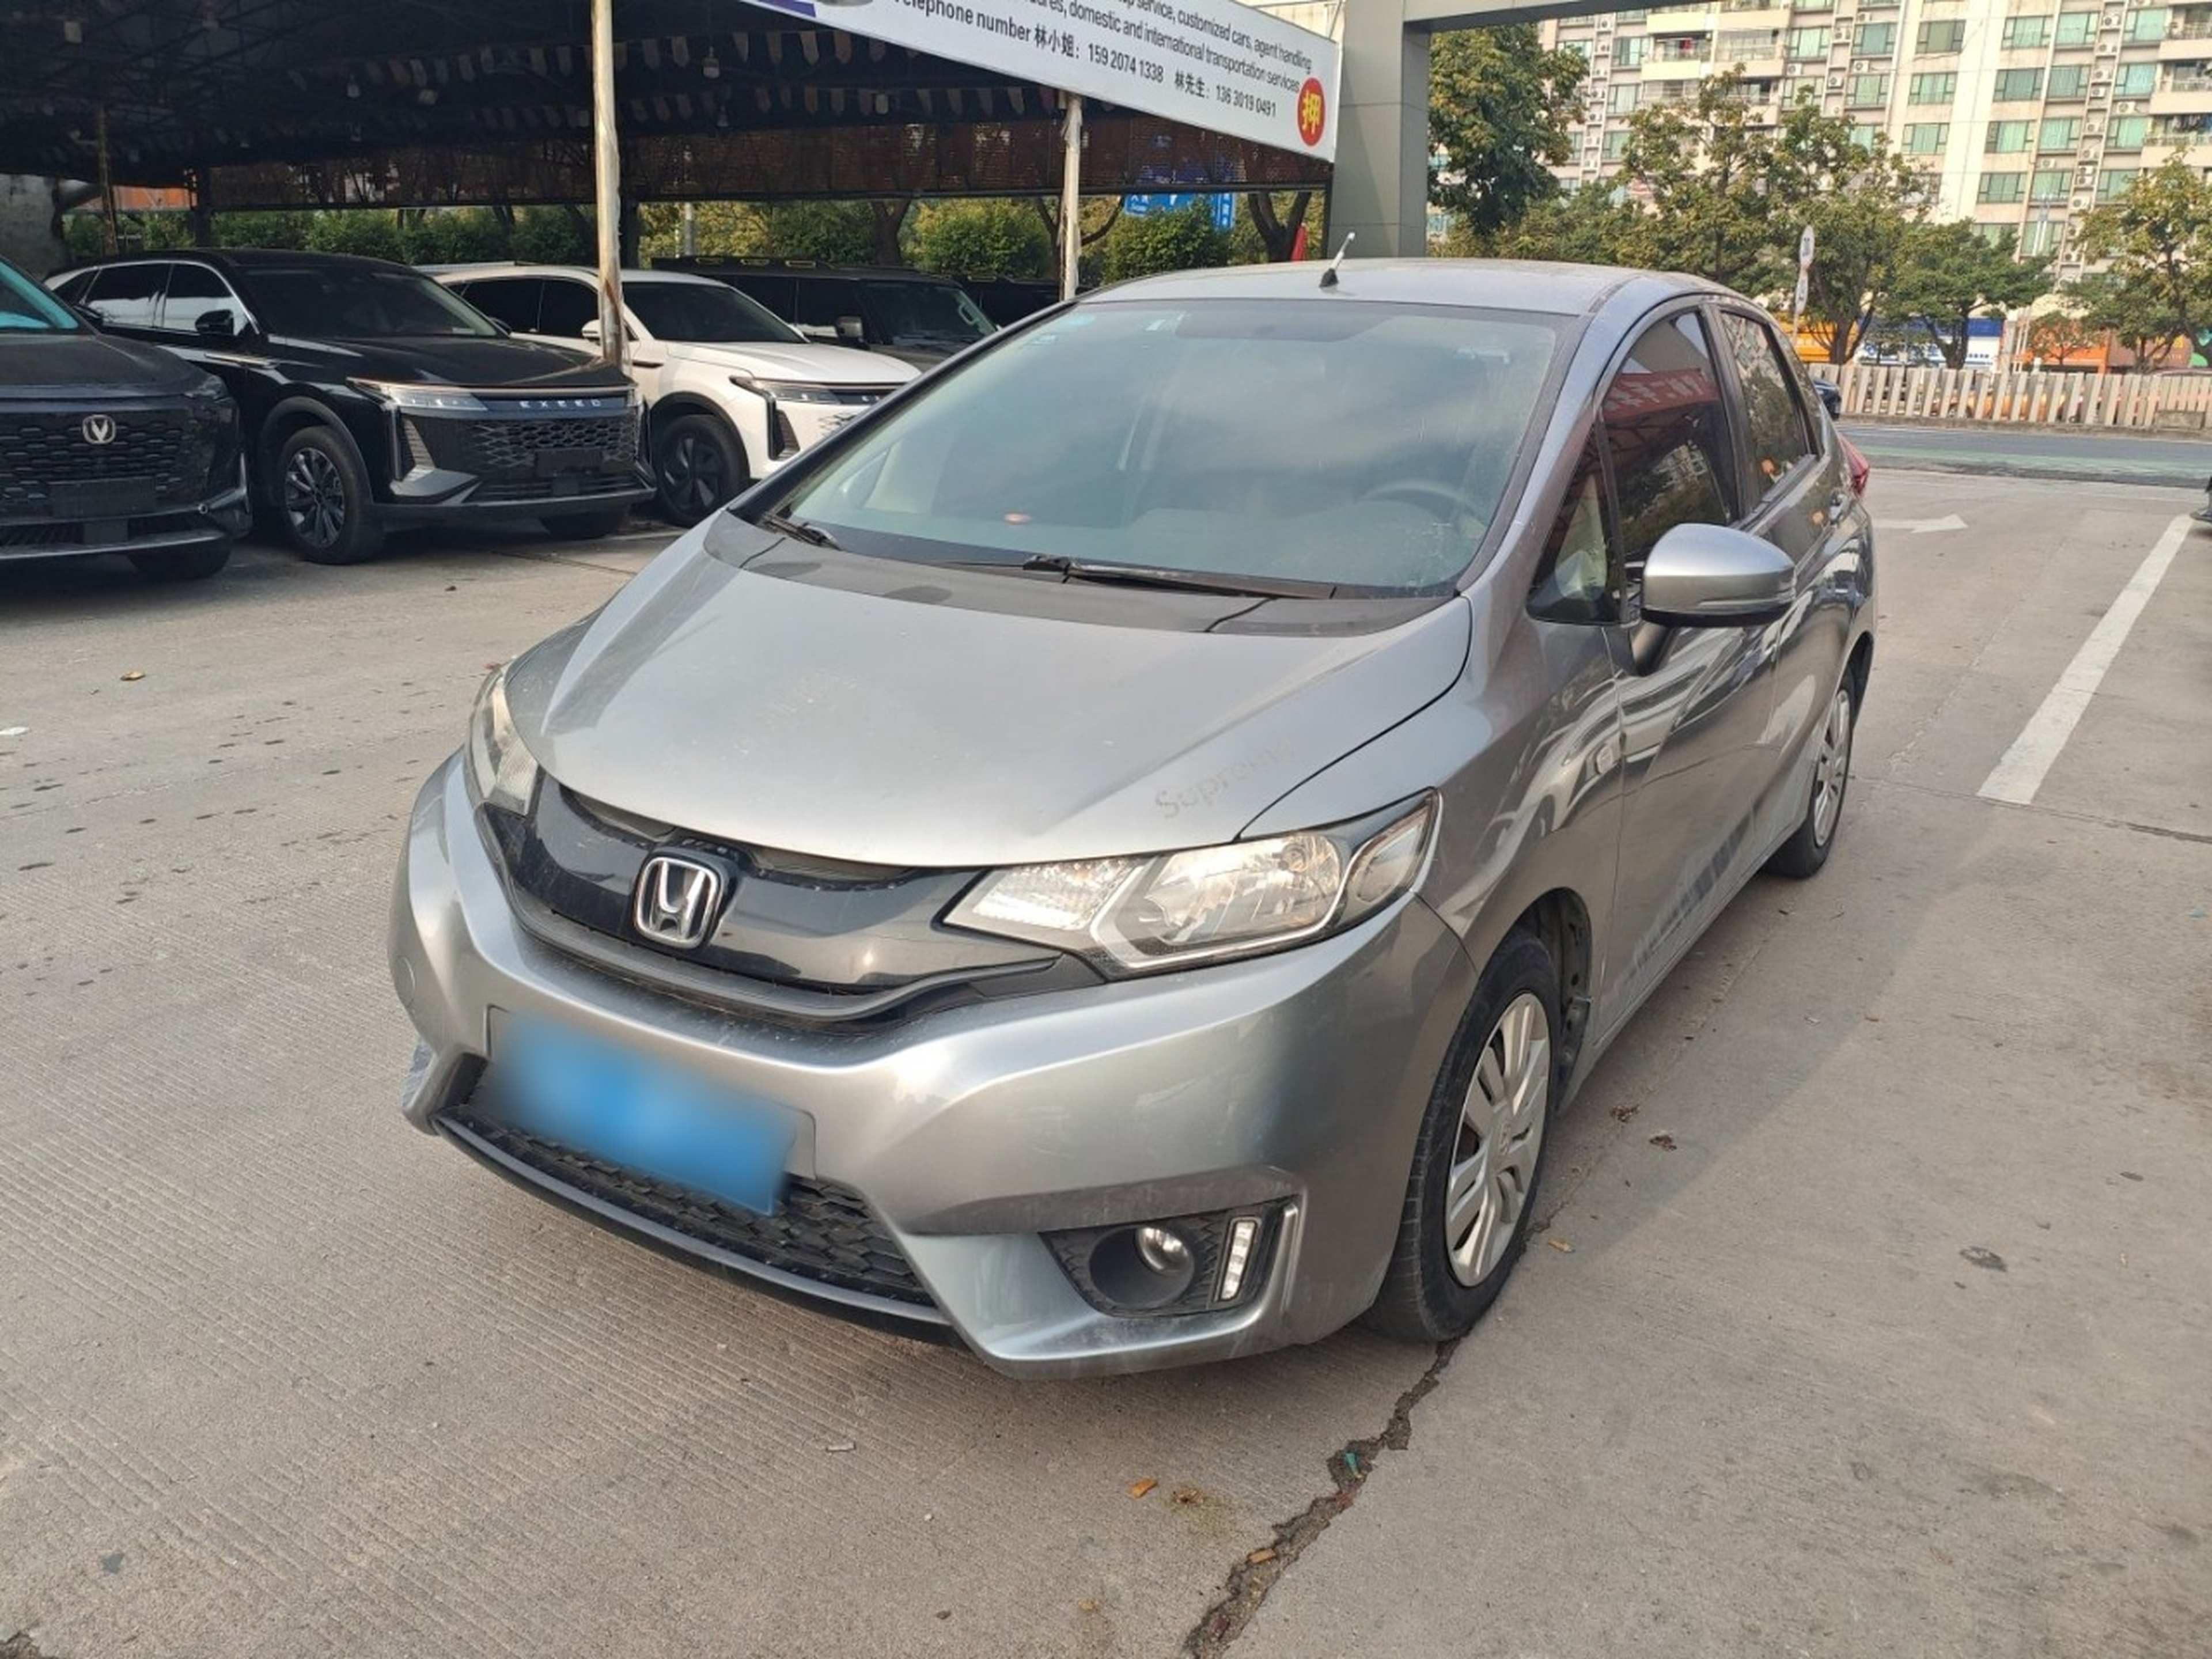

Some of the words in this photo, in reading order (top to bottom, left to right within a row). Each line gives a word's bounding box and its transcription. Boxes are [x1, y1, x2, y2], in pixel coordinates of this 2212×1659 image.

[977, 12, 1031, 41] number
[1088, 43, 1108, 65] 159
[1111, 50, 1136, 74] 2074
[1139, 60, 1164, 83] 1338
[1216, 84, 1231, 105] 136
[1233, 89, 1254, 111] 3019
[1256, 97, 1276, 117] 0491
[1069, 0, 1121, 32] domestic
[1123, 21, 1143, 39] and
[1144, 22, 1205, 60] international
[1206, 47, 1266, 79] transportation
[1267, 71, 1300, 93] services
[1177, 10, 1231, 41] customized
[1254, 39, 1278, 58] agent
[1279, 43, 1312, 74] handling
[1302, 89, 1322, 134] 押
[519, 399, 601, 408] EXEED
